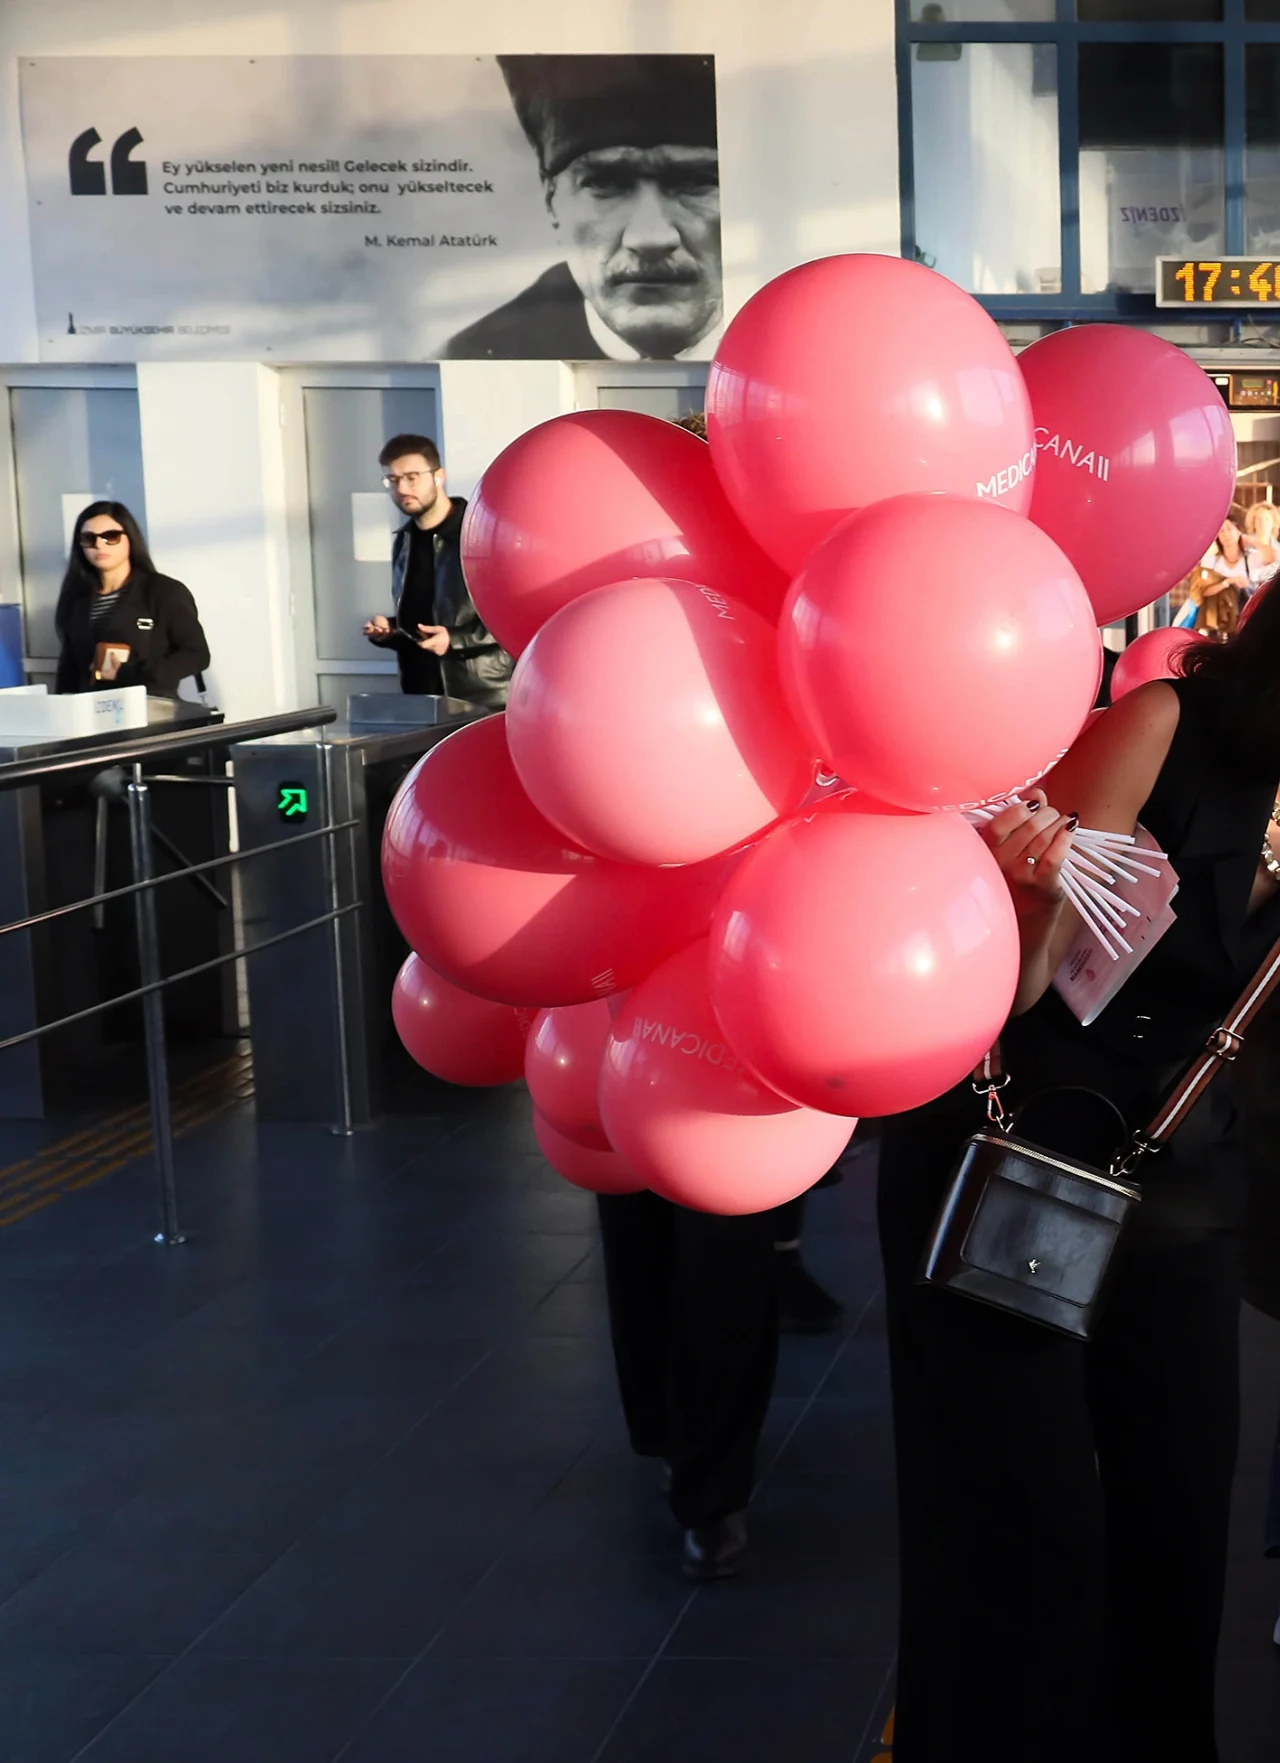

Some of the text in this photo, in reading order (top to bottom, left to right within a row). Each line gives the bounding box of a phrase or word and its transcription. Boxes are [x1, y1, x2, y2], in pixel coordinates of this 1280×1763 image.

[163, 162, 180, 175] Ey
[185, 161, 256, 175] yükselen
[260, 160, 294, 175] yeni
[344, 160, 407, 172] Gelecek
[412, 160, 473, 172] sizindir.
[164, 180, 493, 196] Cumhuriyeti biz kurduk; onu yükseltecek
[165, 201, 381, 214] ve devam ettirecek sizsiniz.
[364, 235, 497, 246] M. Kemal Atatürk
